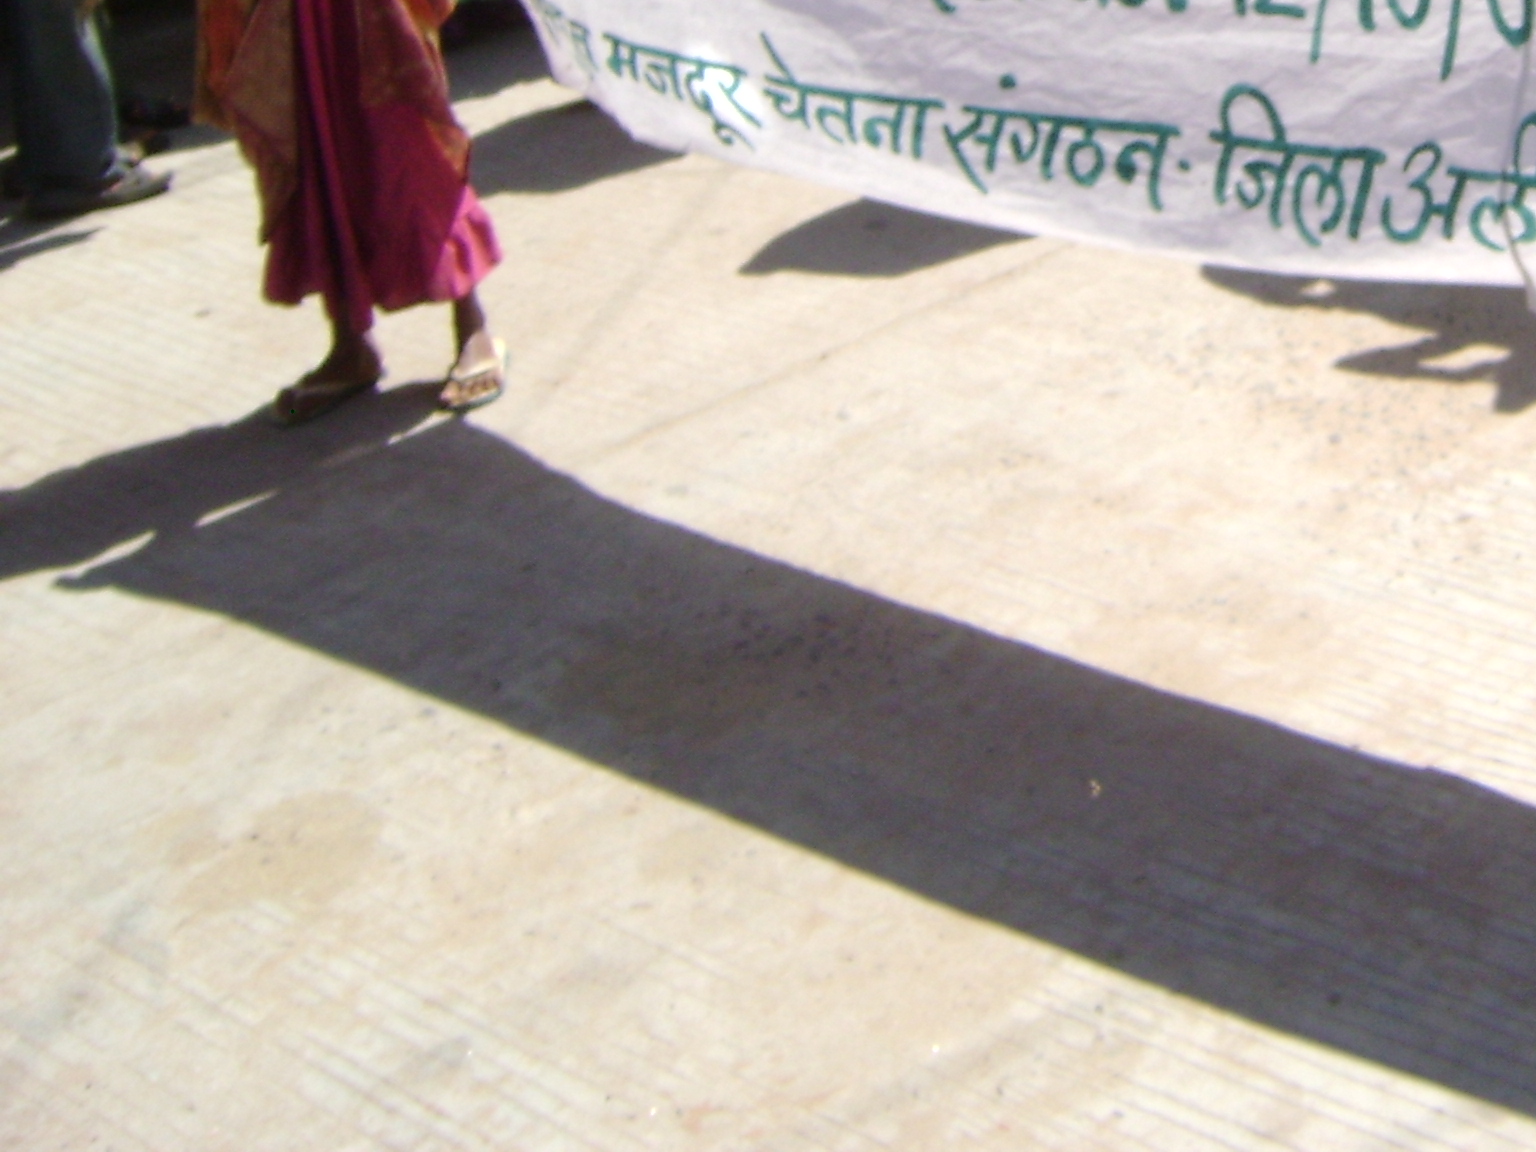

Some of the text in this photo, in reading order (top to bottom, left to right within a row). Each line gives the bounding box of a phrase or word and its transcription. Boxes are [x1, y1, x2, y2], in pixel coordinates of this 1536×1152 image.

[602, 31, 763, 153] मजदूर
[760, 31, 945, 163] चेतना
[1211, 83, 1387, 247] जिला
